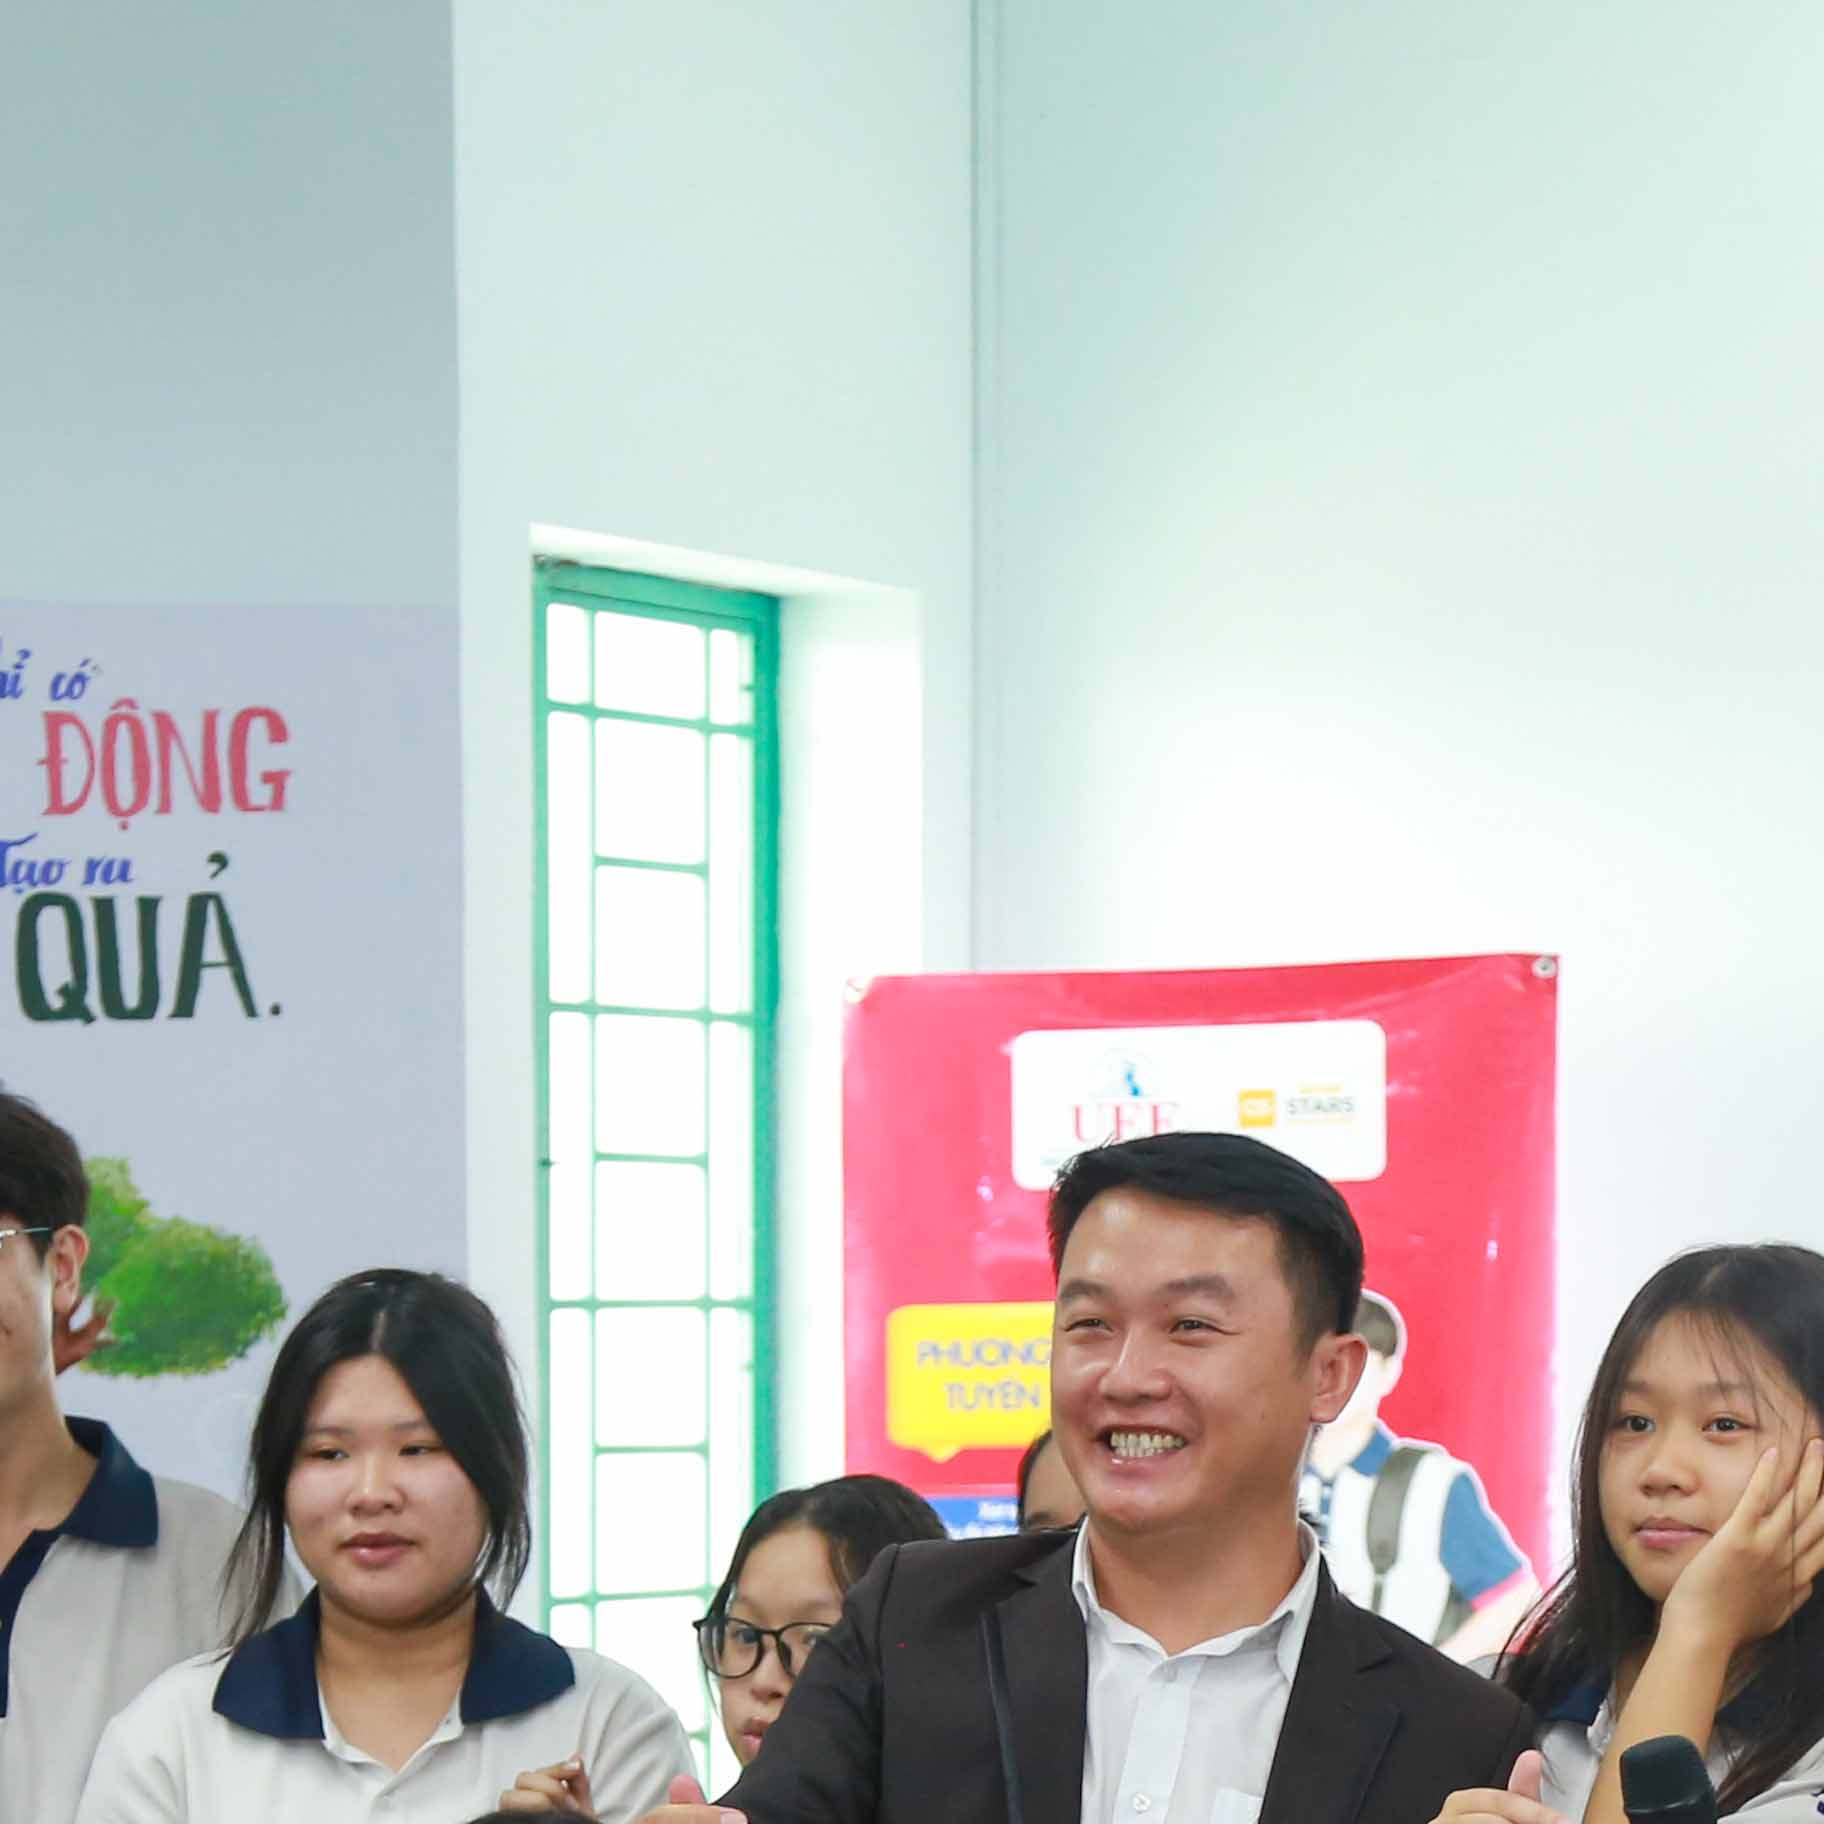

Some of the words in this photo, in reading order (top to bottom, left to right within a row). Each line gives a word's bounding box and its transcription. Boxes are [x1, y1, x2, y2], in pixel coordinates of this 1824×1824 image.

[50, 657, 96, 701] có
[37, 698, 293, 831] ĐỘNG
[82, 855, 135, 887] ra
[14, 851, 283, 1026] QUẢ.
